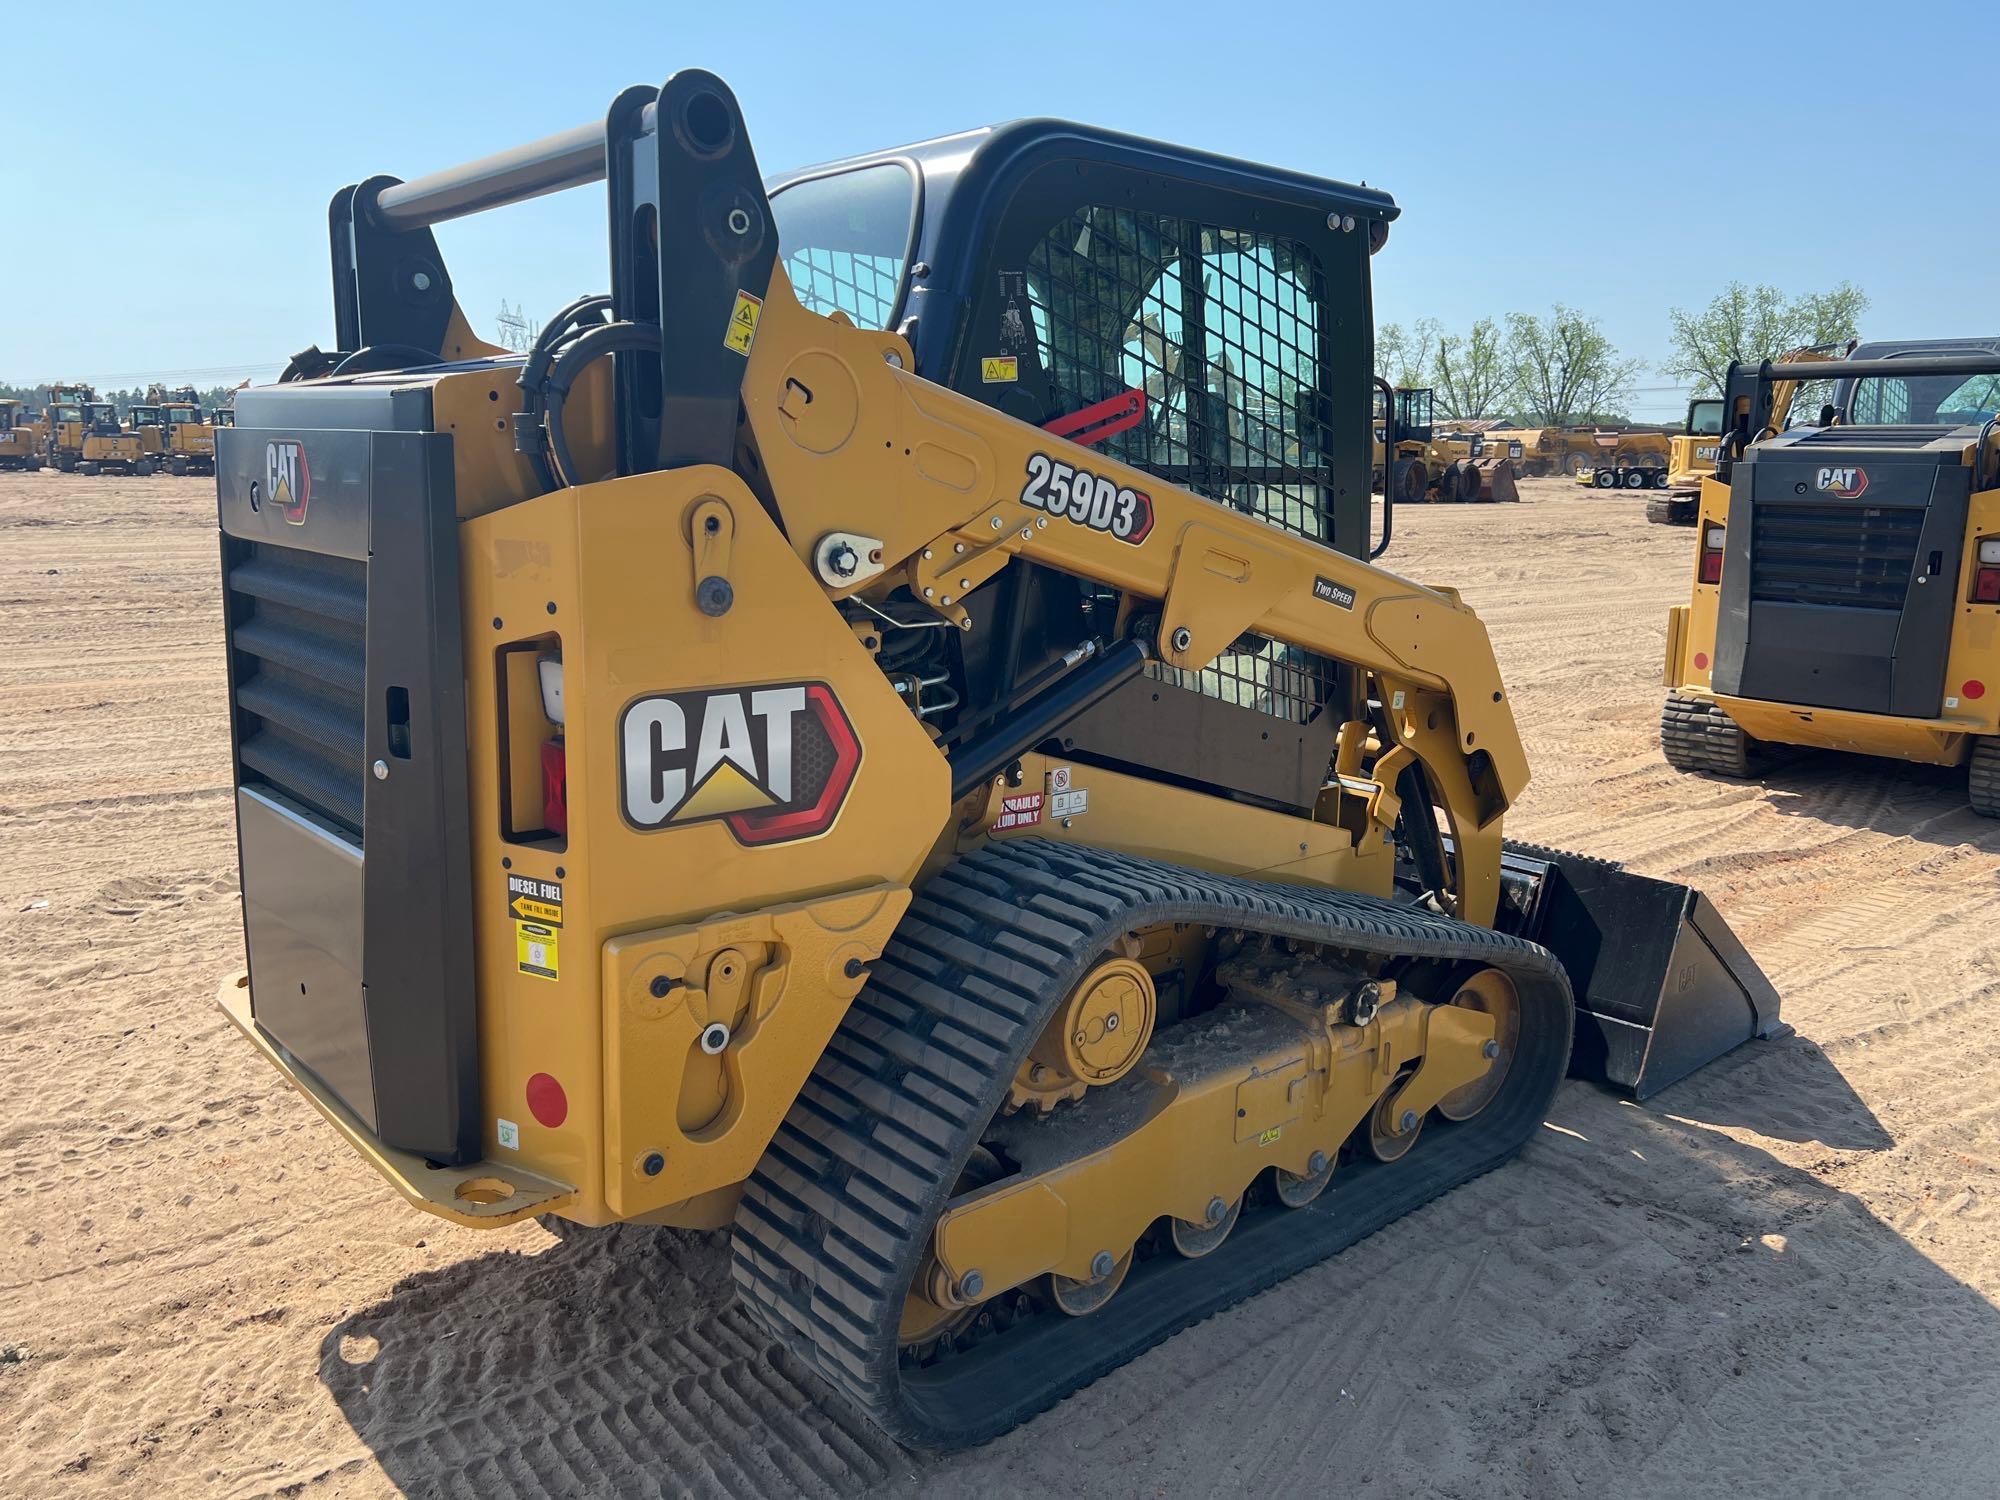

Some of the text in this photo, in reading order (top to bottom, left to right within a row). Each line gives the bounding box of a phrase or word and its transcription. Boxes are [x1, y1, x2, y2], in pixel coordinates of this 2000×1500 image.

[1696, 446, 1717, 460] CAT
[266, 443, 297, 503] CAT
[1817, 468, 1856, 490] CAT
[1022, 455, 1137, 537] 259D3
[623, 687, 806, 824] CAT
[992, 811, 1039, 829] LUID ONLY
[509, 877, 562, 901] DIESEL FUEL
[520, 902, 559, 918] TANK FILL INSIDE
